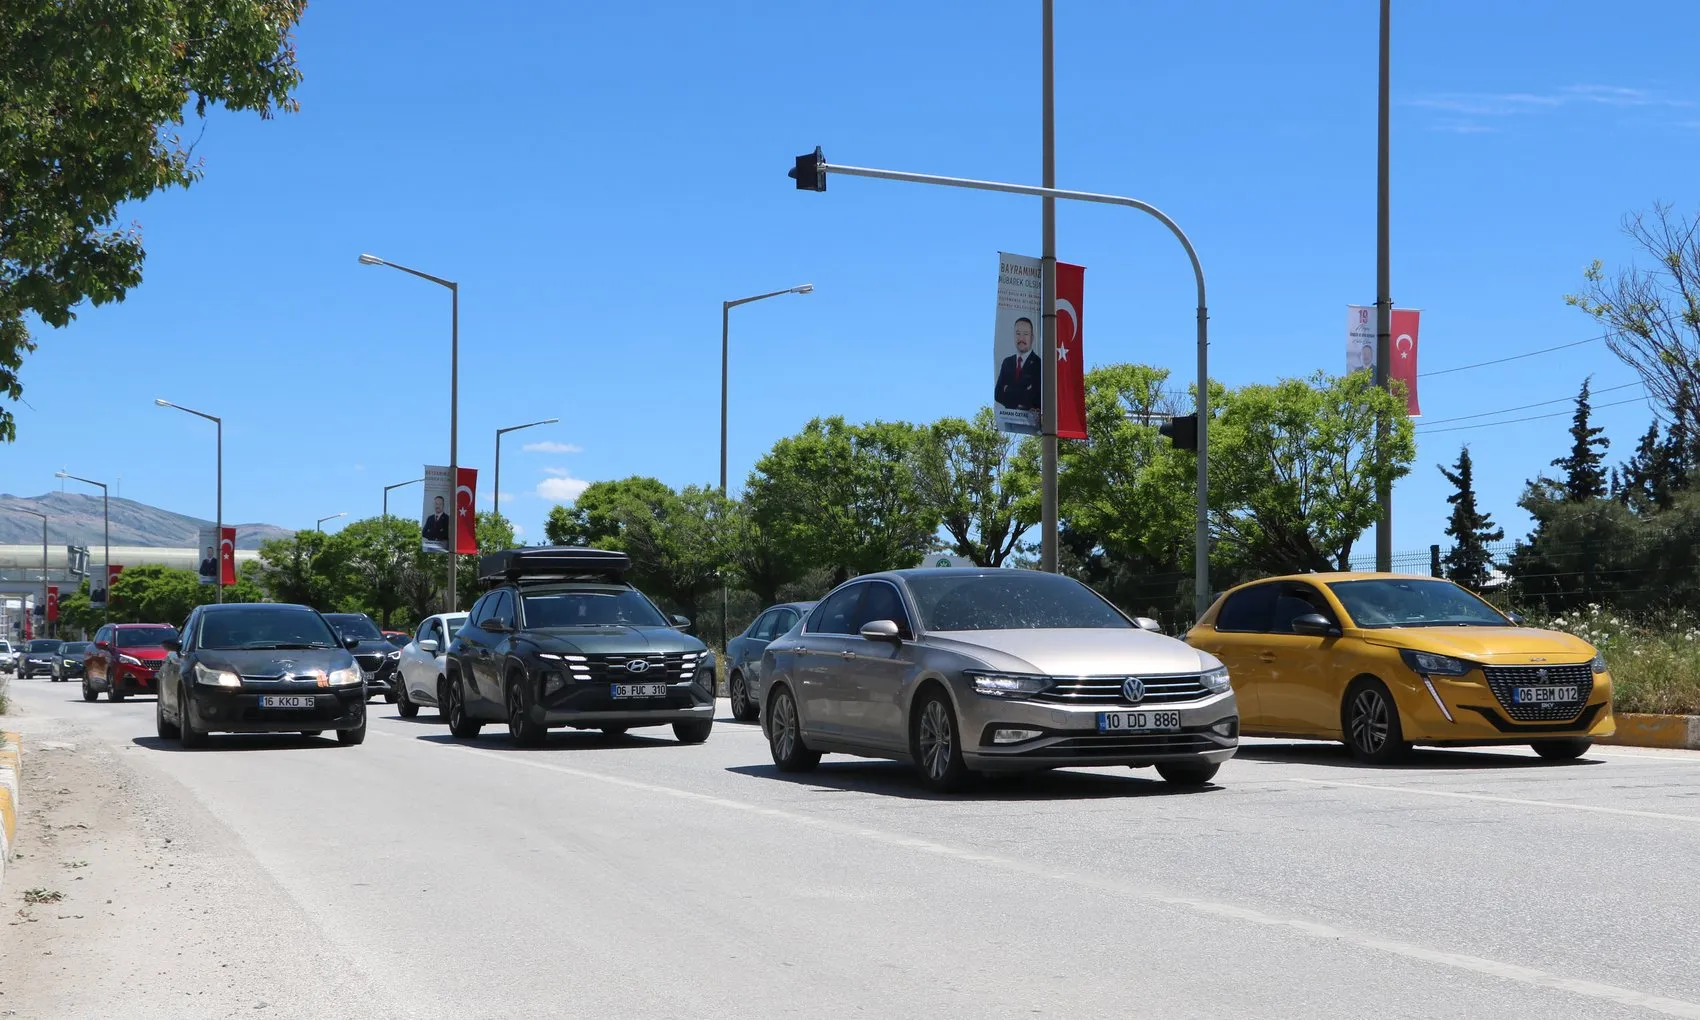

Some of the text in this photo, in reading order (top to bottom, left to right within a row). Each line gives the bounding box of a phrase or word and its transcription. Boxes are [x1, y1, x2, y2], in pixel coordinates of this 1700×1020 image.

[616, 685, 666, 696] 06 FUC 310
[1520, 687, 1577, 702] 06 EBM 012
[264, 697, 314, 706] 16 KKD 15
[1106, 712, 1178, 729] 10 DD 886
